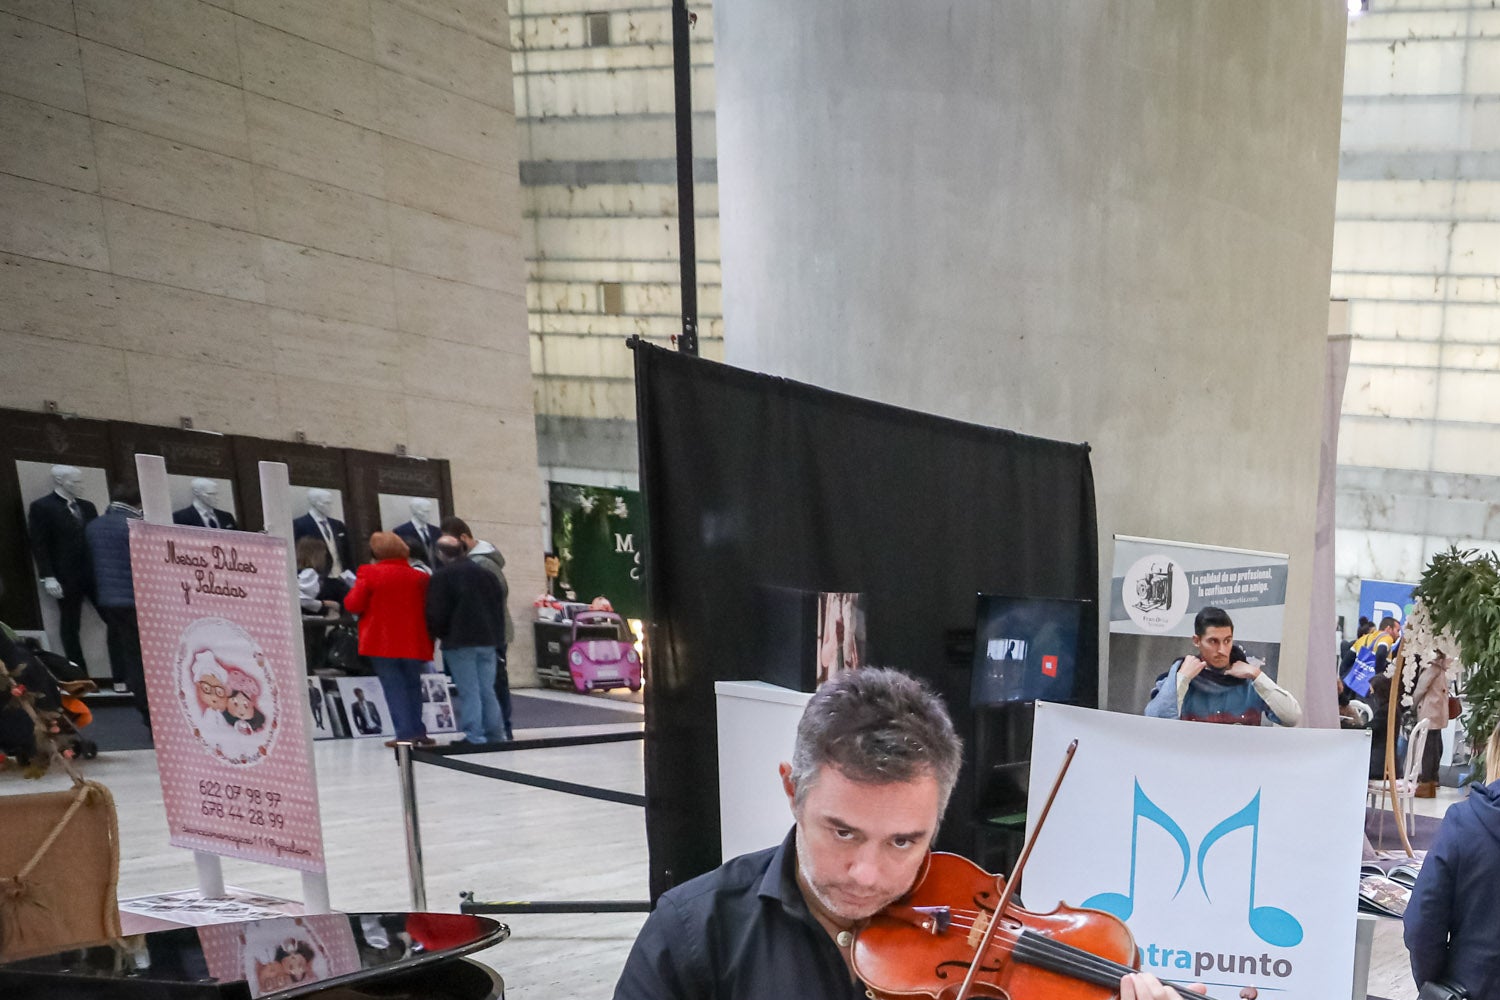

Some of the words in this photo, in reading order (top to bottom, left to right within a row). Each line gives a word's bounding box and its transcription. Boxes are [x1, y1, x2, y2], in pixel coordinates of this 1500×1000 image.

[164, 540, 208, 568] Mesas
[211, 545, 257, 574] Dulces
[181, 581, 191, 605] y
[195, 569, 248, 598] Saladas
[1199, 571, 1222, 584] calidad
[1204, 584, 1233, 596] confianza
[199, 779, 222, 798] 622
[225, 784, 241, 800] 07
[245, 788, 261, 805] 98
[265, 791, 281, 808] 97
[201, 800, 225, 818] 678
[228, 805, 245, 820] 44
[248, 808, 265, 826] 28
[268, 812, 284, 829] 99
